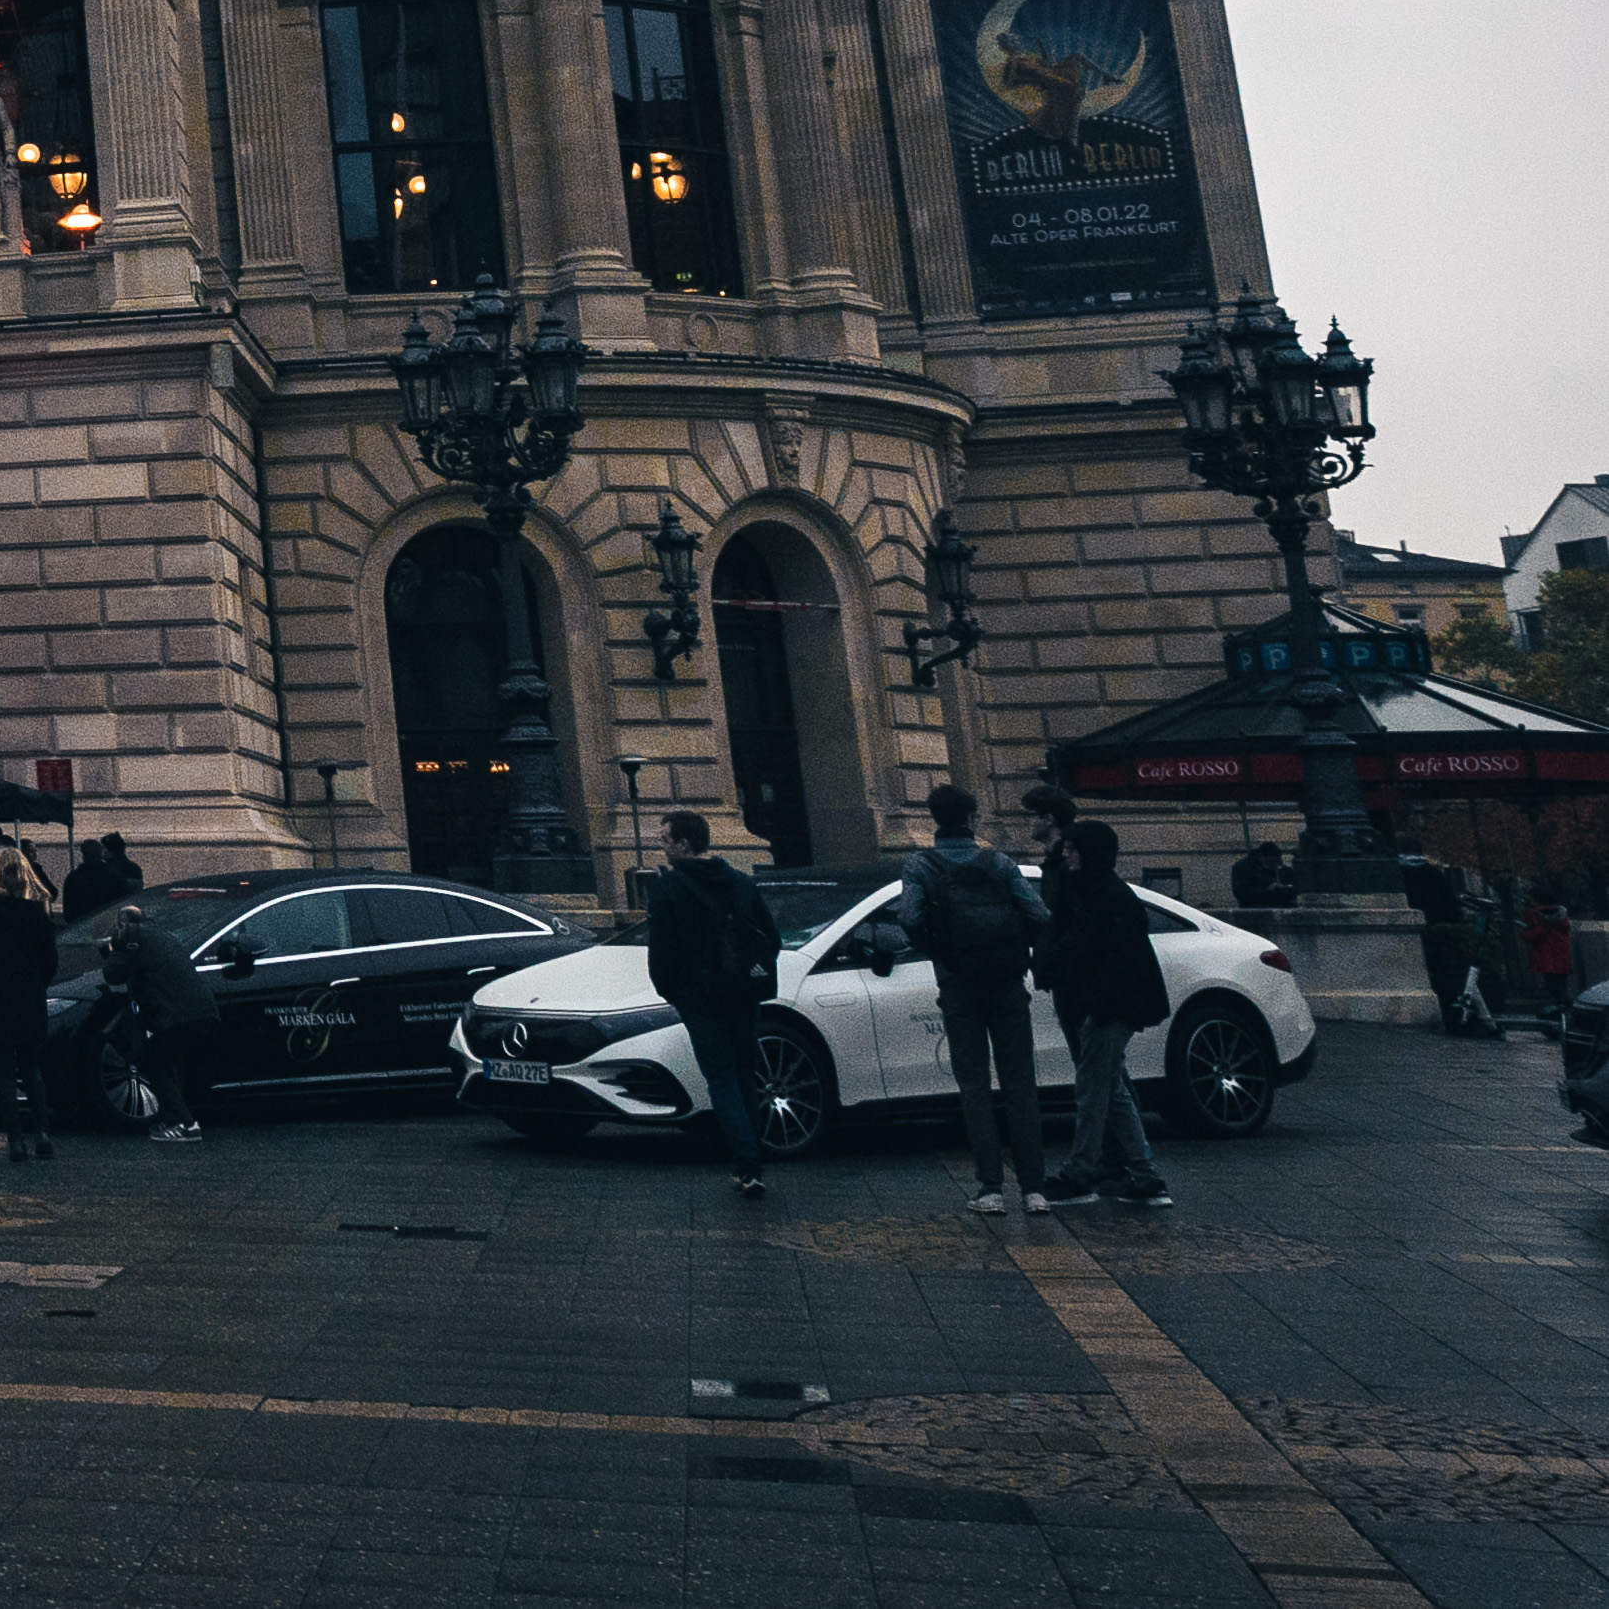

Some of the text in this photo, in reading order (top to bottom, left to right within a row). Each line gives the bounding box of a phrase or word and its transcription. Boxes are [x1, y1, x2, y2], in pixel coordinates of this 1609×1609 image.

[986, 142, 1162, 182] BERLIN BERLIN
[1012, 211, 1047, 228] 04.
[1064, 203, 1151, 225] 08.01.22
[989, 220, 1179, 247] ALTE OPER FRANKFURT
[1178, 759, 1240, 777] ROSSO
[1447, 754, 1520, 773] ROSSO
[278, 1011, 356, 1027] MARKEN GALA
